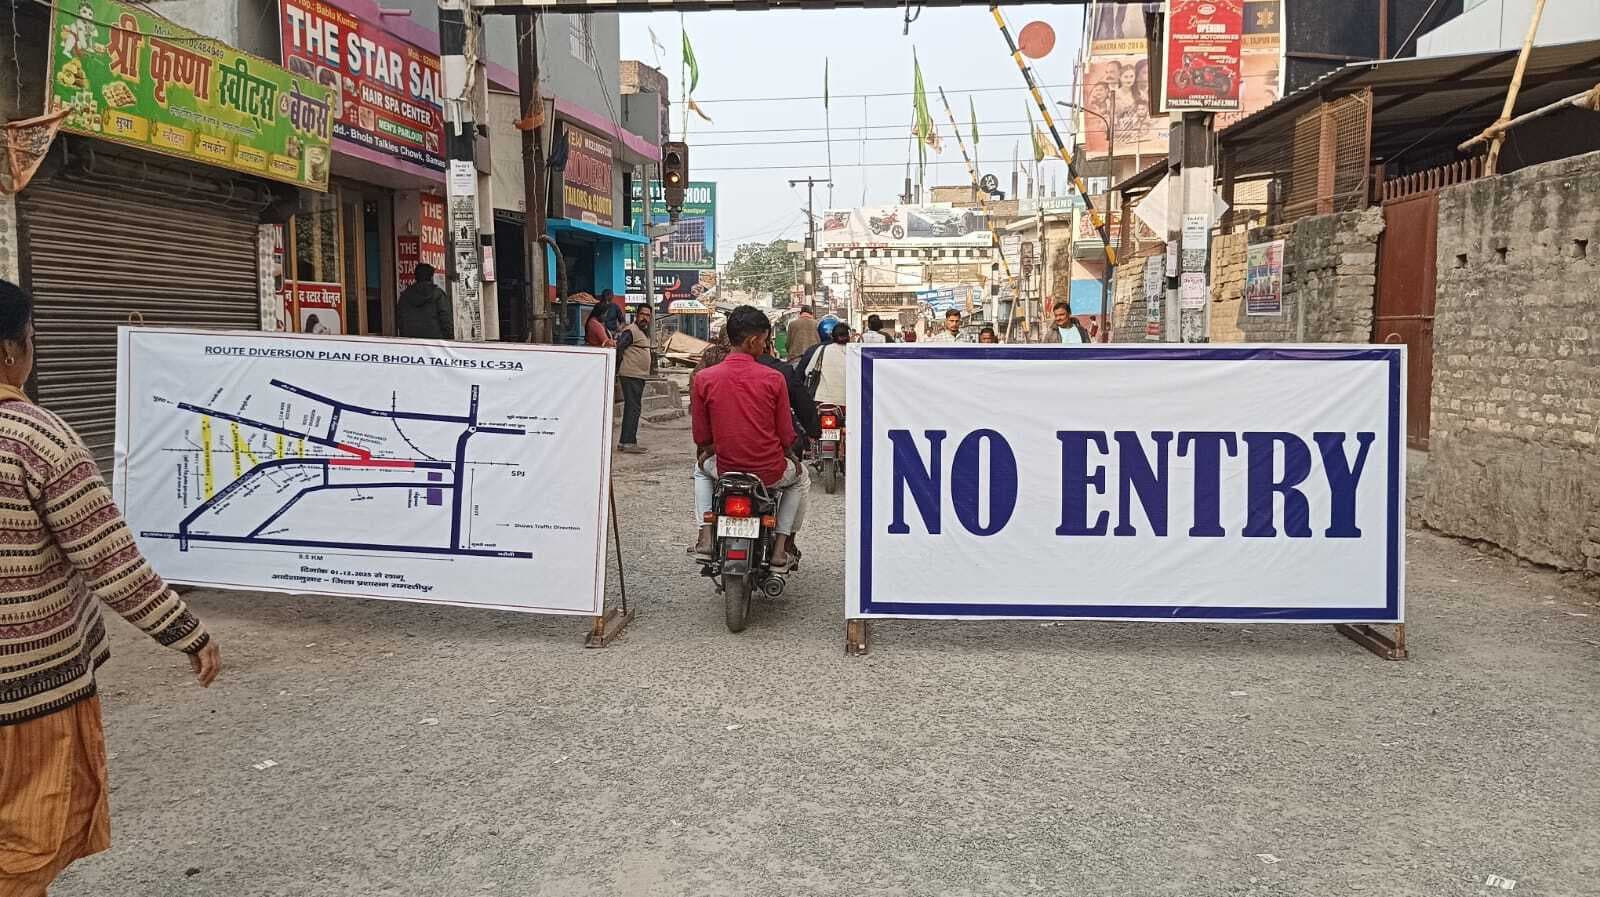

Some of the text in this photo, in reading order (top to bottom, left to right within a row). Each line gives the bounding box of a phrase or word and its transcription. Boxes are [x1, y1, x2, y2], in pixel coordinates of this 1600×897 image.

[337, 11, 358, 29] Kumar
[109, 14, 144, 78] श्री
[151, 38, 212, 102] कृष्णा
[287, 4, 340, 63] THE
[347, 33, 403, 91] STAR
[362, 86, 431, 126] HAIR SPA CENTER
[350, 129, 373, 144] Bhola
[374, 137, 399, 153] Talkies
[400, 146, 425, 162] Chowk,
[423, 201, 442, 220] THE
[421, 224, 444, 246] STAR
[400, 242, 417, 255] THE
[634, 275, 642, 285] &
[642, 275, 675, 285] HILLI
[205, 345, 524, 371] ROUTE DIVERSION PLAN FOR BHOLA TALKIES LC-53A
[888, 429, 1376, 538] NO ENTRY
